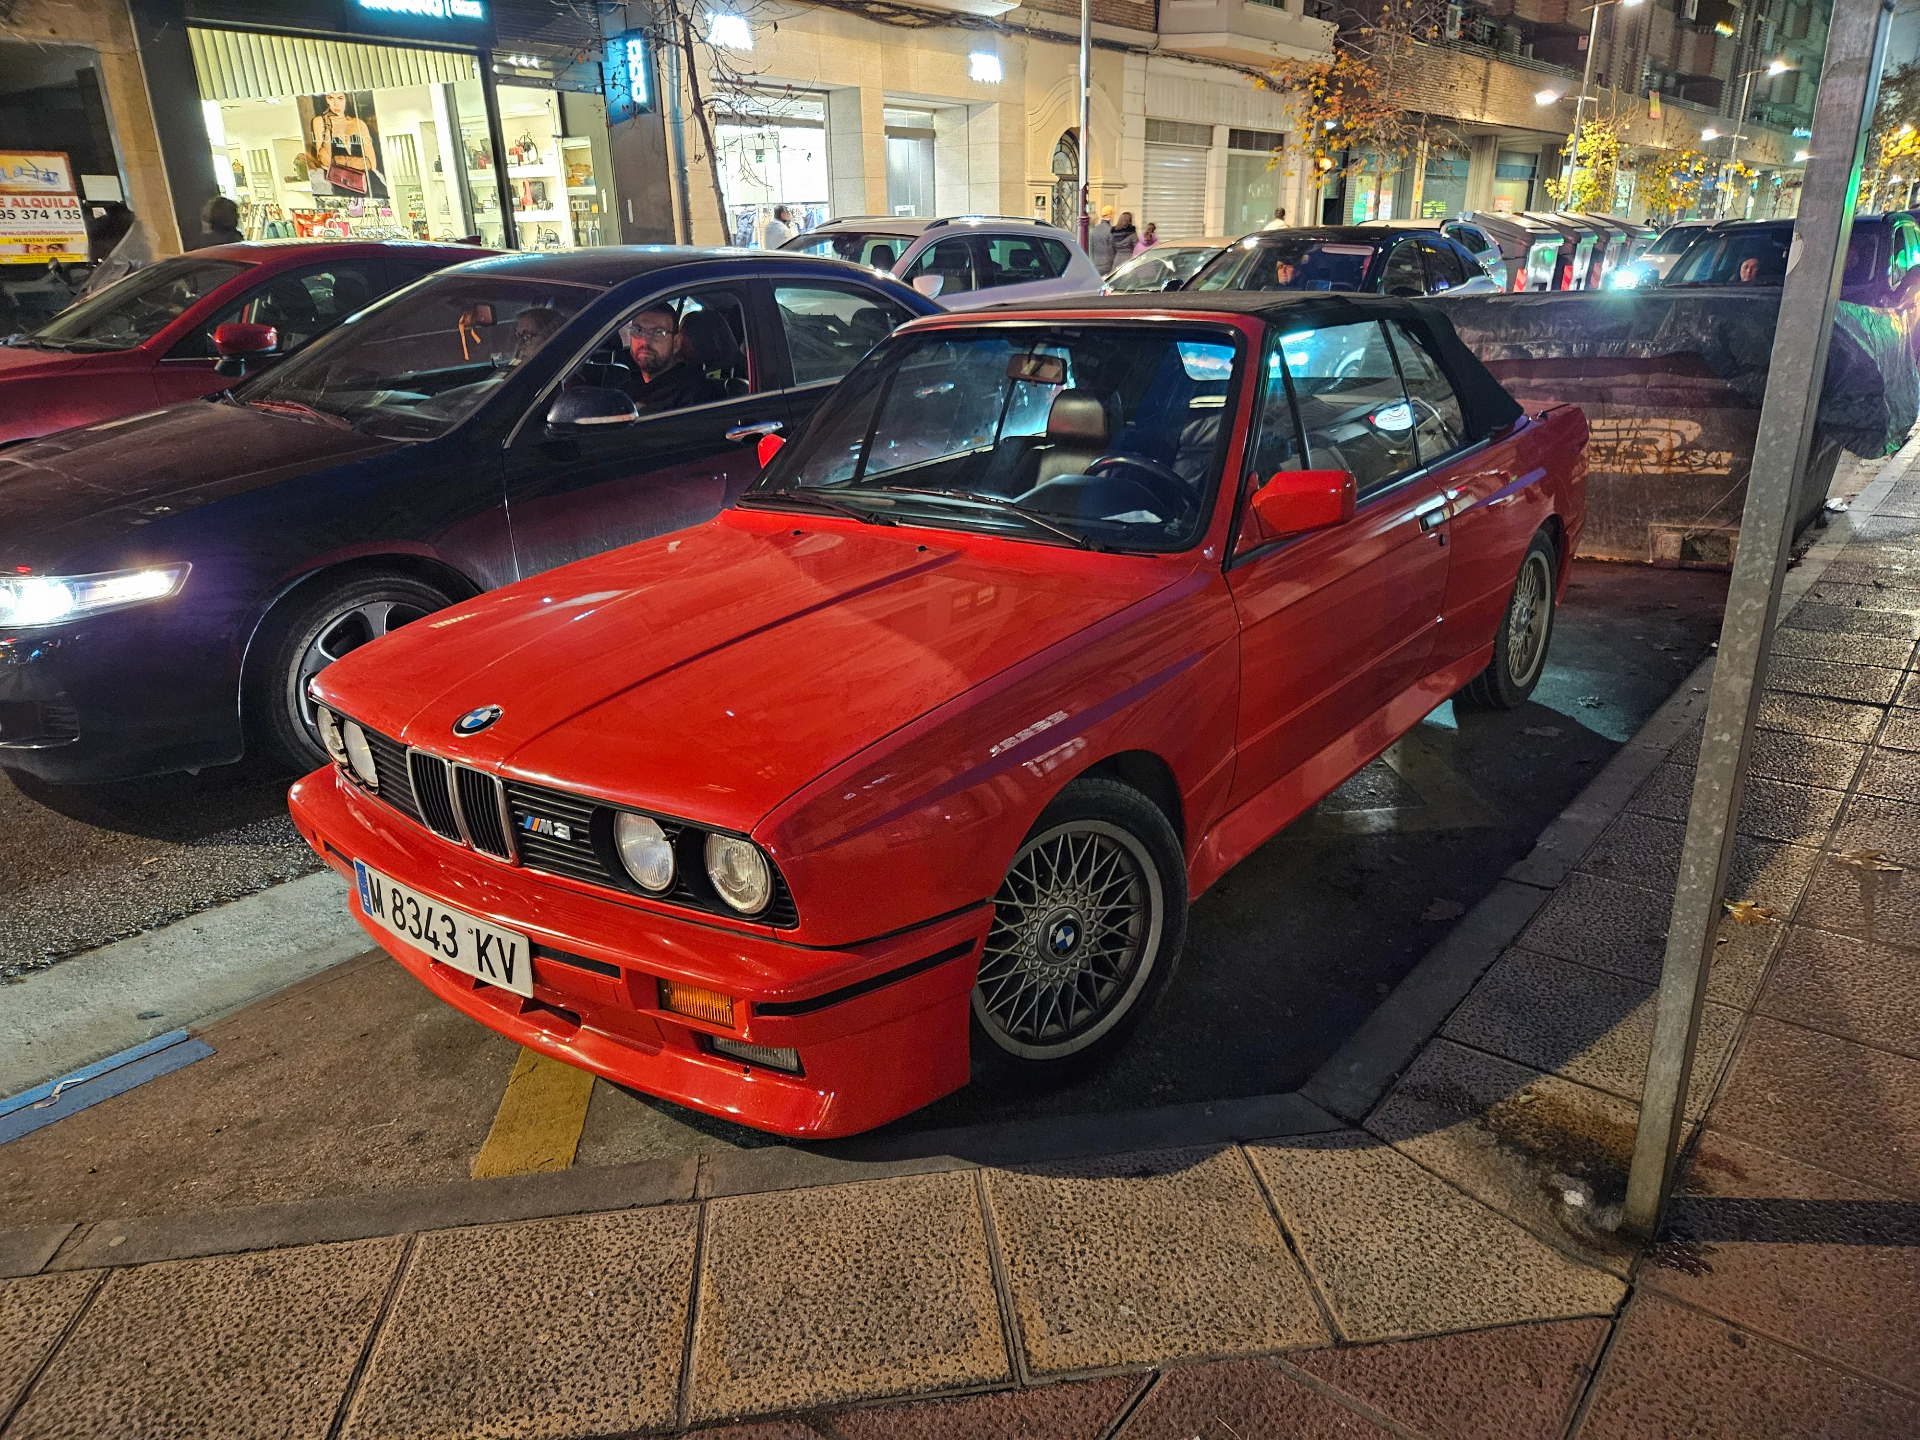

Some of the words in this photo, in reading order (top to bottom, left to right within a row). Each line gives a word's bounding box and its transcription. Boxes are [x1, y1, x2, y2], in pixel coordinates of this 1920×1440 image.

[11, 197, 78, 208] ALQUILA
[21, 209, 49, 219] 374
[54, 209, 82, 219] 135
[538, 818, 571, 841] M3
[362, 893, 370, 907] E
[367, 871, 385, 919] M
[391, 888, 459, 959] 8343
[475, 928, 516, 985] KV
